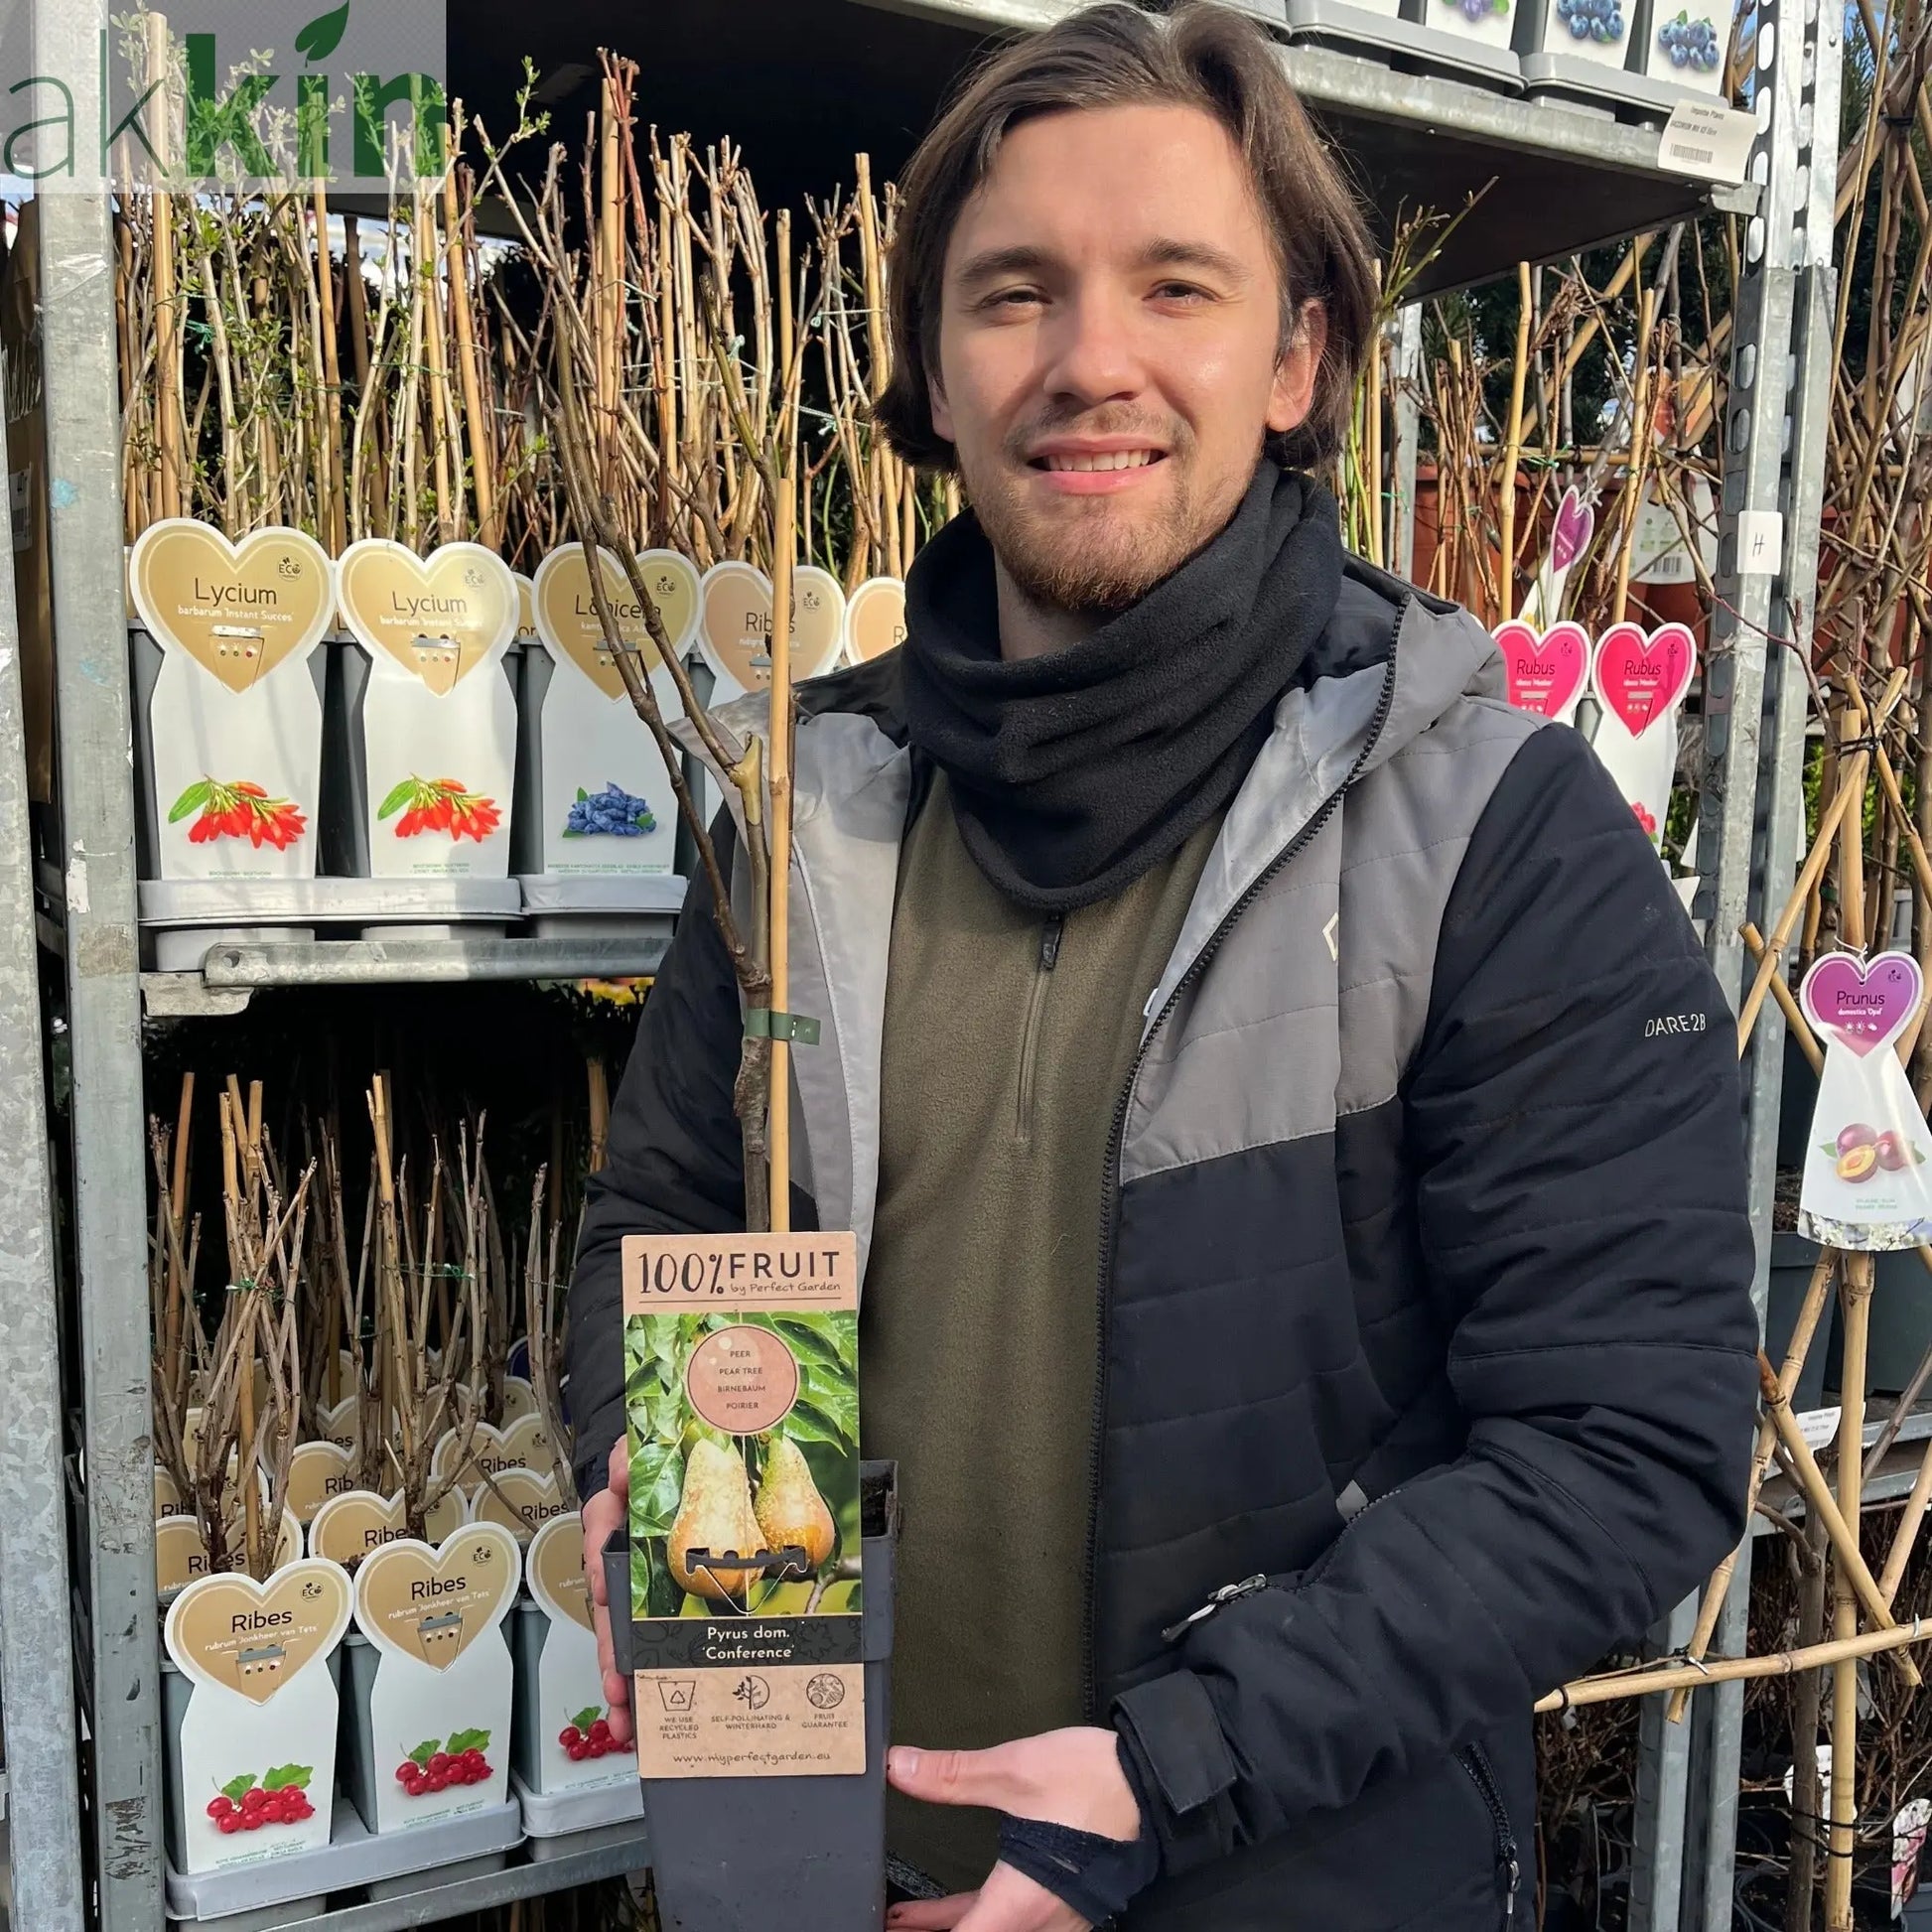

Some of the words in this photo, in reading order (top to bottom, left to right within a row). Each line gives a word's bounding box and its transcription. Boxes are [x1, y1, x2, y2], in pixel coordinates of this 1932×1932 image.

[195, 577, 278, 608] Lycium
[178, 605, 223, 618] barbarum
[391, 591, 468, 617] Lycium
[746, 612, 796, 634] Ribs
[1516, 658, 1556, 676] Rubus
[1623, 659, 1662, 676] Rubus
[1837, 990, 1885, 1006] Prunus
[1644, 1013, 1707, 1037] DARE2B
[638, 1252, 725, 1295] 100%
[730, 1251, 840, 1279] FRUIT
[730, 1283, 746, 1296] by
[750, 1282, 795, 1293] Perfect
[797, 1282, 841, 1293] Garden
[742, 1366, 763, 1375] TREE
[364, 1526, 408, 1548] Ribe
[188, 1552, 246, 1575] Ries
[411, 1577, 467, 1601] Ribes
[388, 1607, 417, 1620] rubrum
[456, 1594, 471, 1603] van
[231, 1609, 293, 1633] Ribes
[205, 1639, 237, 1651] rubrum
[280, 1628, 296, 1637] van
[707, 1626, 749, 1643] Pyrus
[753, 1624, 790, 1639] dom.
[673, 1750, 831, 1766] www.myperfectgarden.eu
